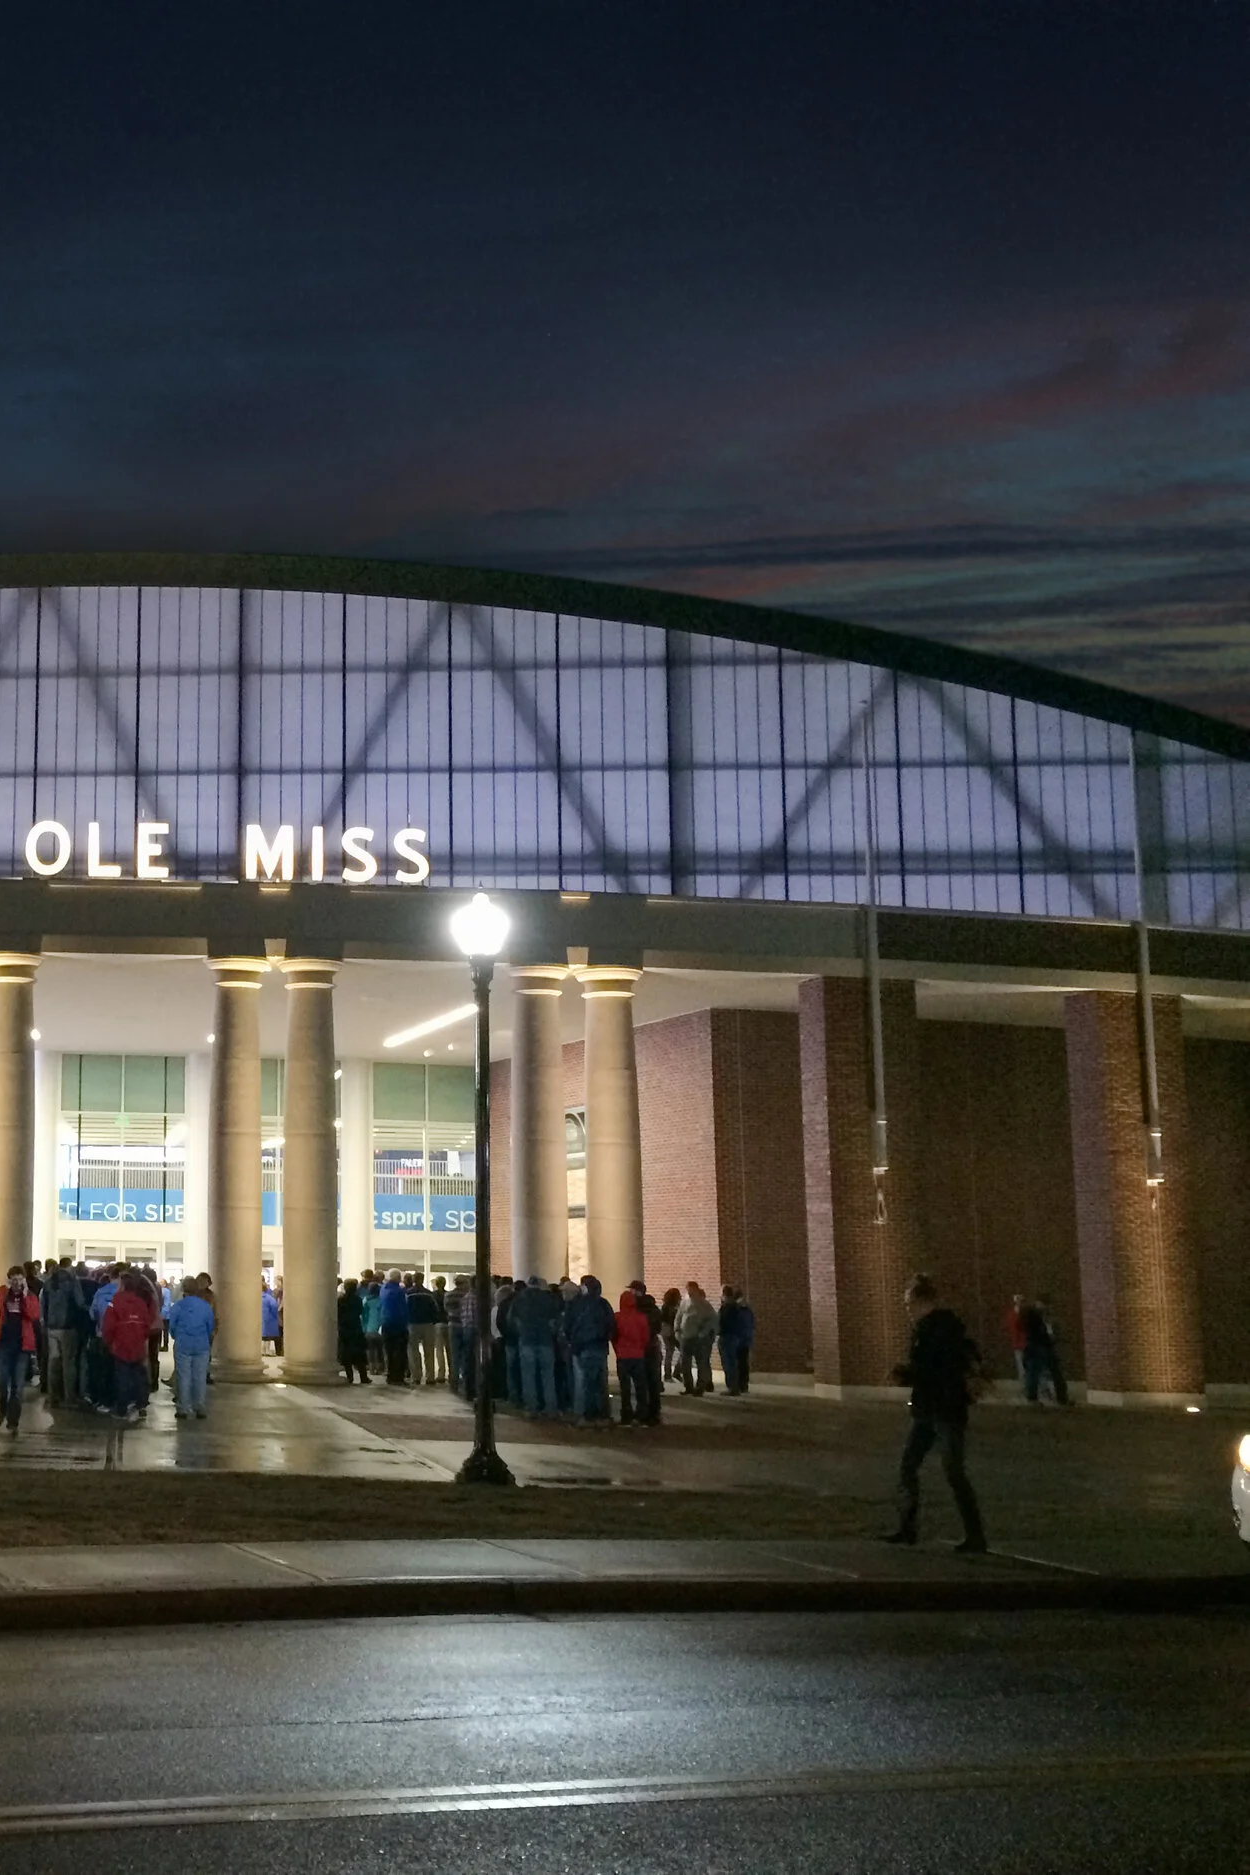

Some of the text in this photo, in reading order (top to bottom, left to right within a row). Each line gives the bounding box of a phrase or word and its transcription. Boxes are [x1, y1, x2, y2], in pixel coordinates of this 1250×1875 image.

[25, 821, 170, 879] OLE
[246, 824, 430, 883] MISS
[90, 1203, 137, 1221] FOR
[381, 1211, 434, 1229] spire
